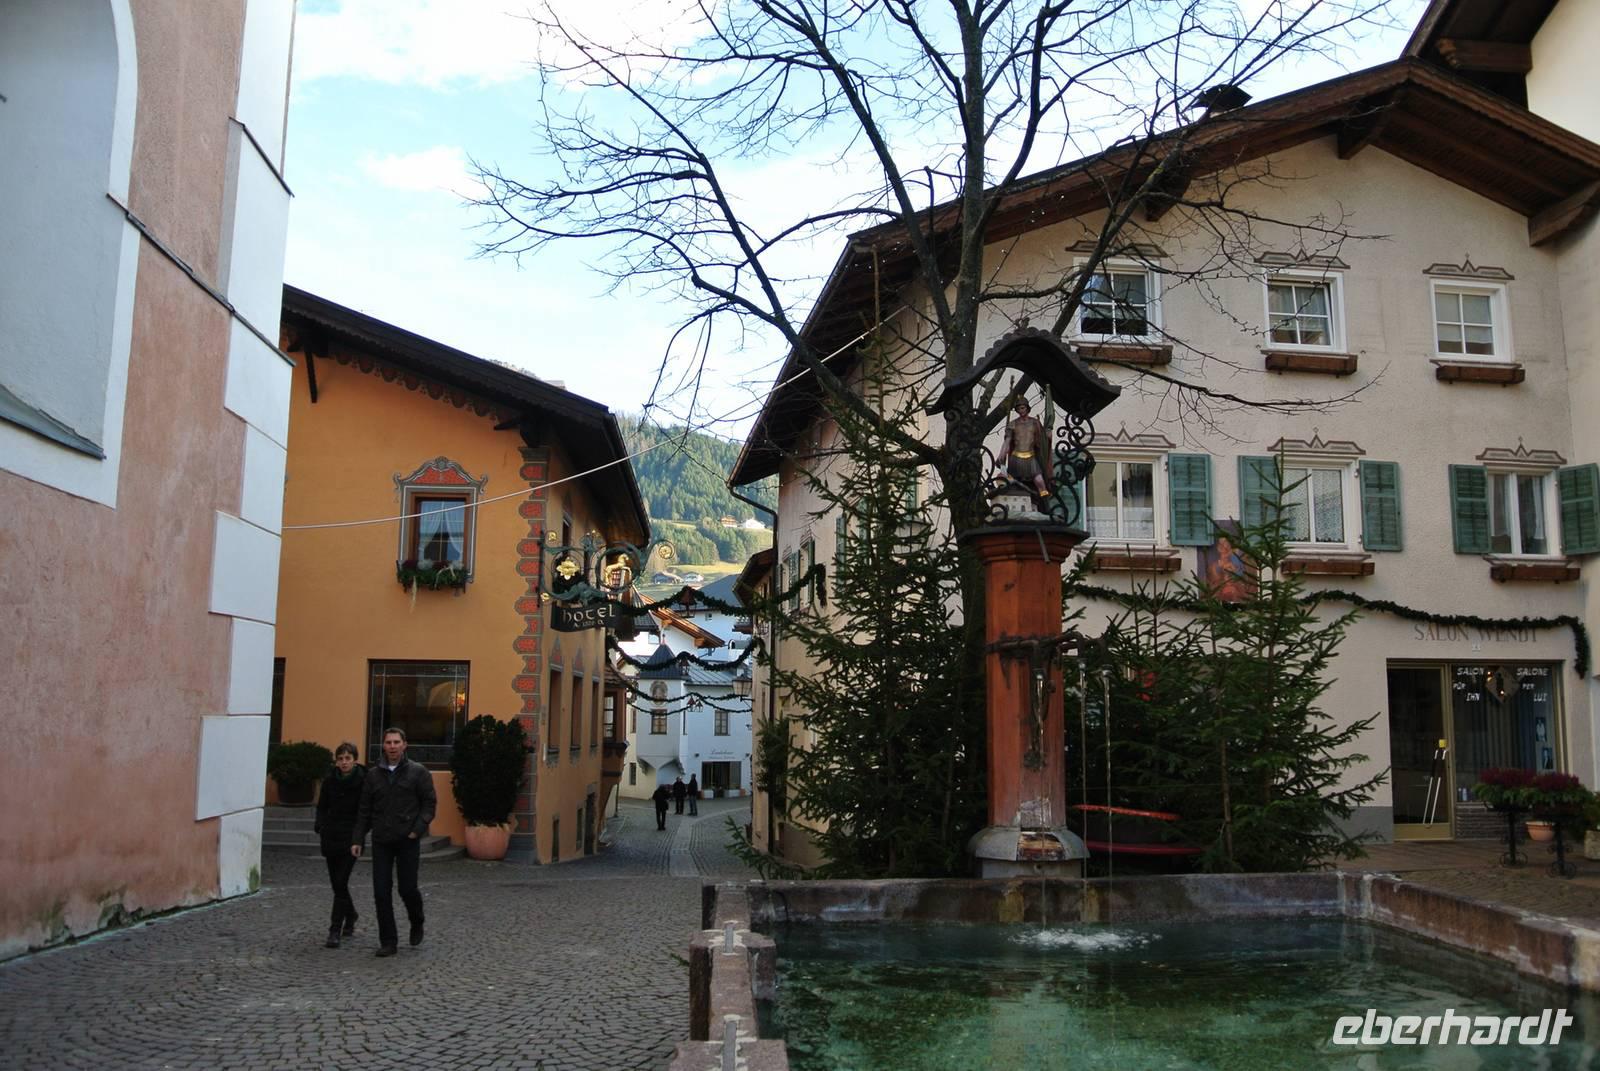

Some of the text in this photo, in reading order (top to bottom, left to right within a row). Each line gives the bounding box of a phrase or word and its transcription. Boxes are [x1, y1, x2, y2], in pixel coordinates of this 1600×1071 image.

[1457, 667, 1485, 675] SALON
[1516, 667, 1549, 676] SALONE
[1466, 692, 1481, 701] IHN
[1533, 693, 1547, 702] LUI
